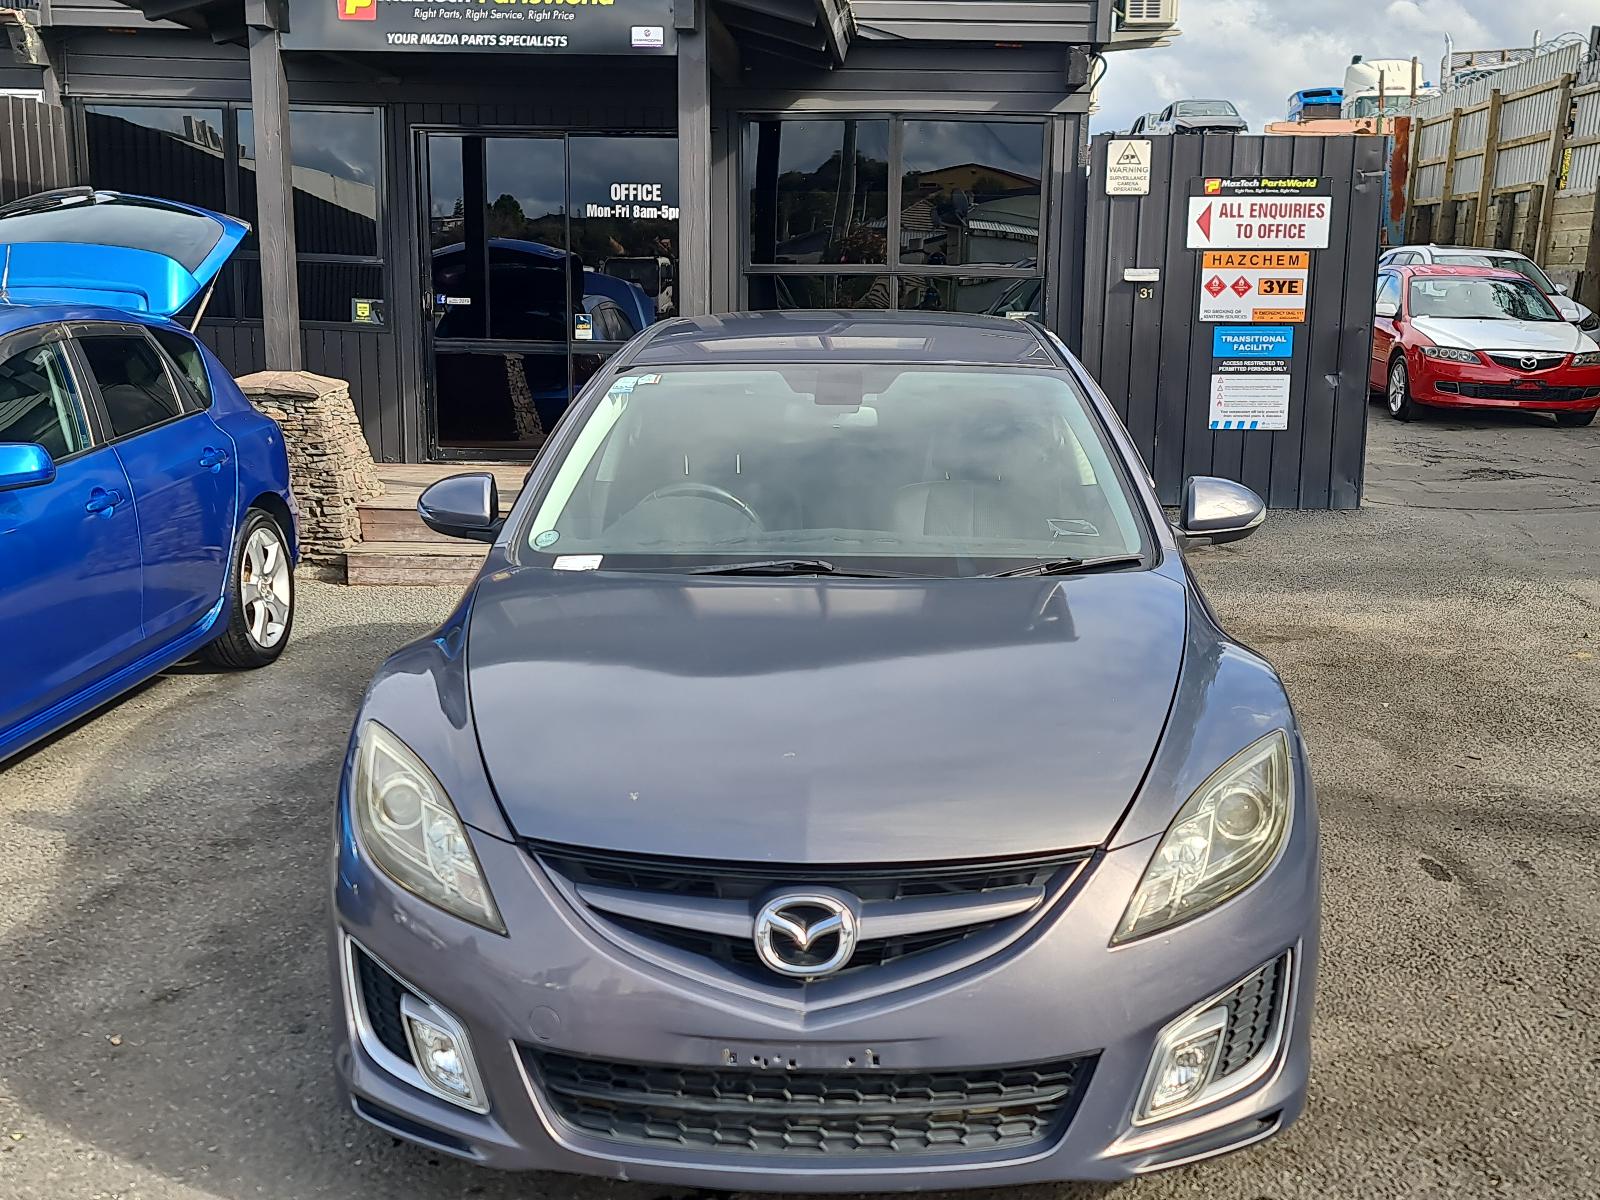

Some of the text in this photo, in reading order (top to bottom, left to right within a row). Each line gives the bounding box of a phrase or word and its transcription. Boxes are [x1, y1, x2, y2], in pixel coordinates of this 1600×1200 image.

[413, 8, 575, 22] Right Parts, Right Service, Right Price
[386, 33, 568, 47] YOUR MAZDA PARTS SPECIALISTS
[1109, 166, 1149, 174] WARNING
[1221, 178, 1317, 188] MazTech PartsWorld
[610, 183, 662, 202] OFFICE
[586, 203, 630, 218] Mon-Fri
[1219, 203, 1326, 220] ALL ENQUIRIES
[1235, 223, 1307, 239] TO OFFICE
[1212, 254, 1300, 266] HAZCHEM
[1139, 287, 1154, 299] 31
[1263, 279, 1299, 294] 3YE
[1221, 335, 1287, 343] TRANSITIONAL
[1233, 343, 1275, 351] FACILITY
